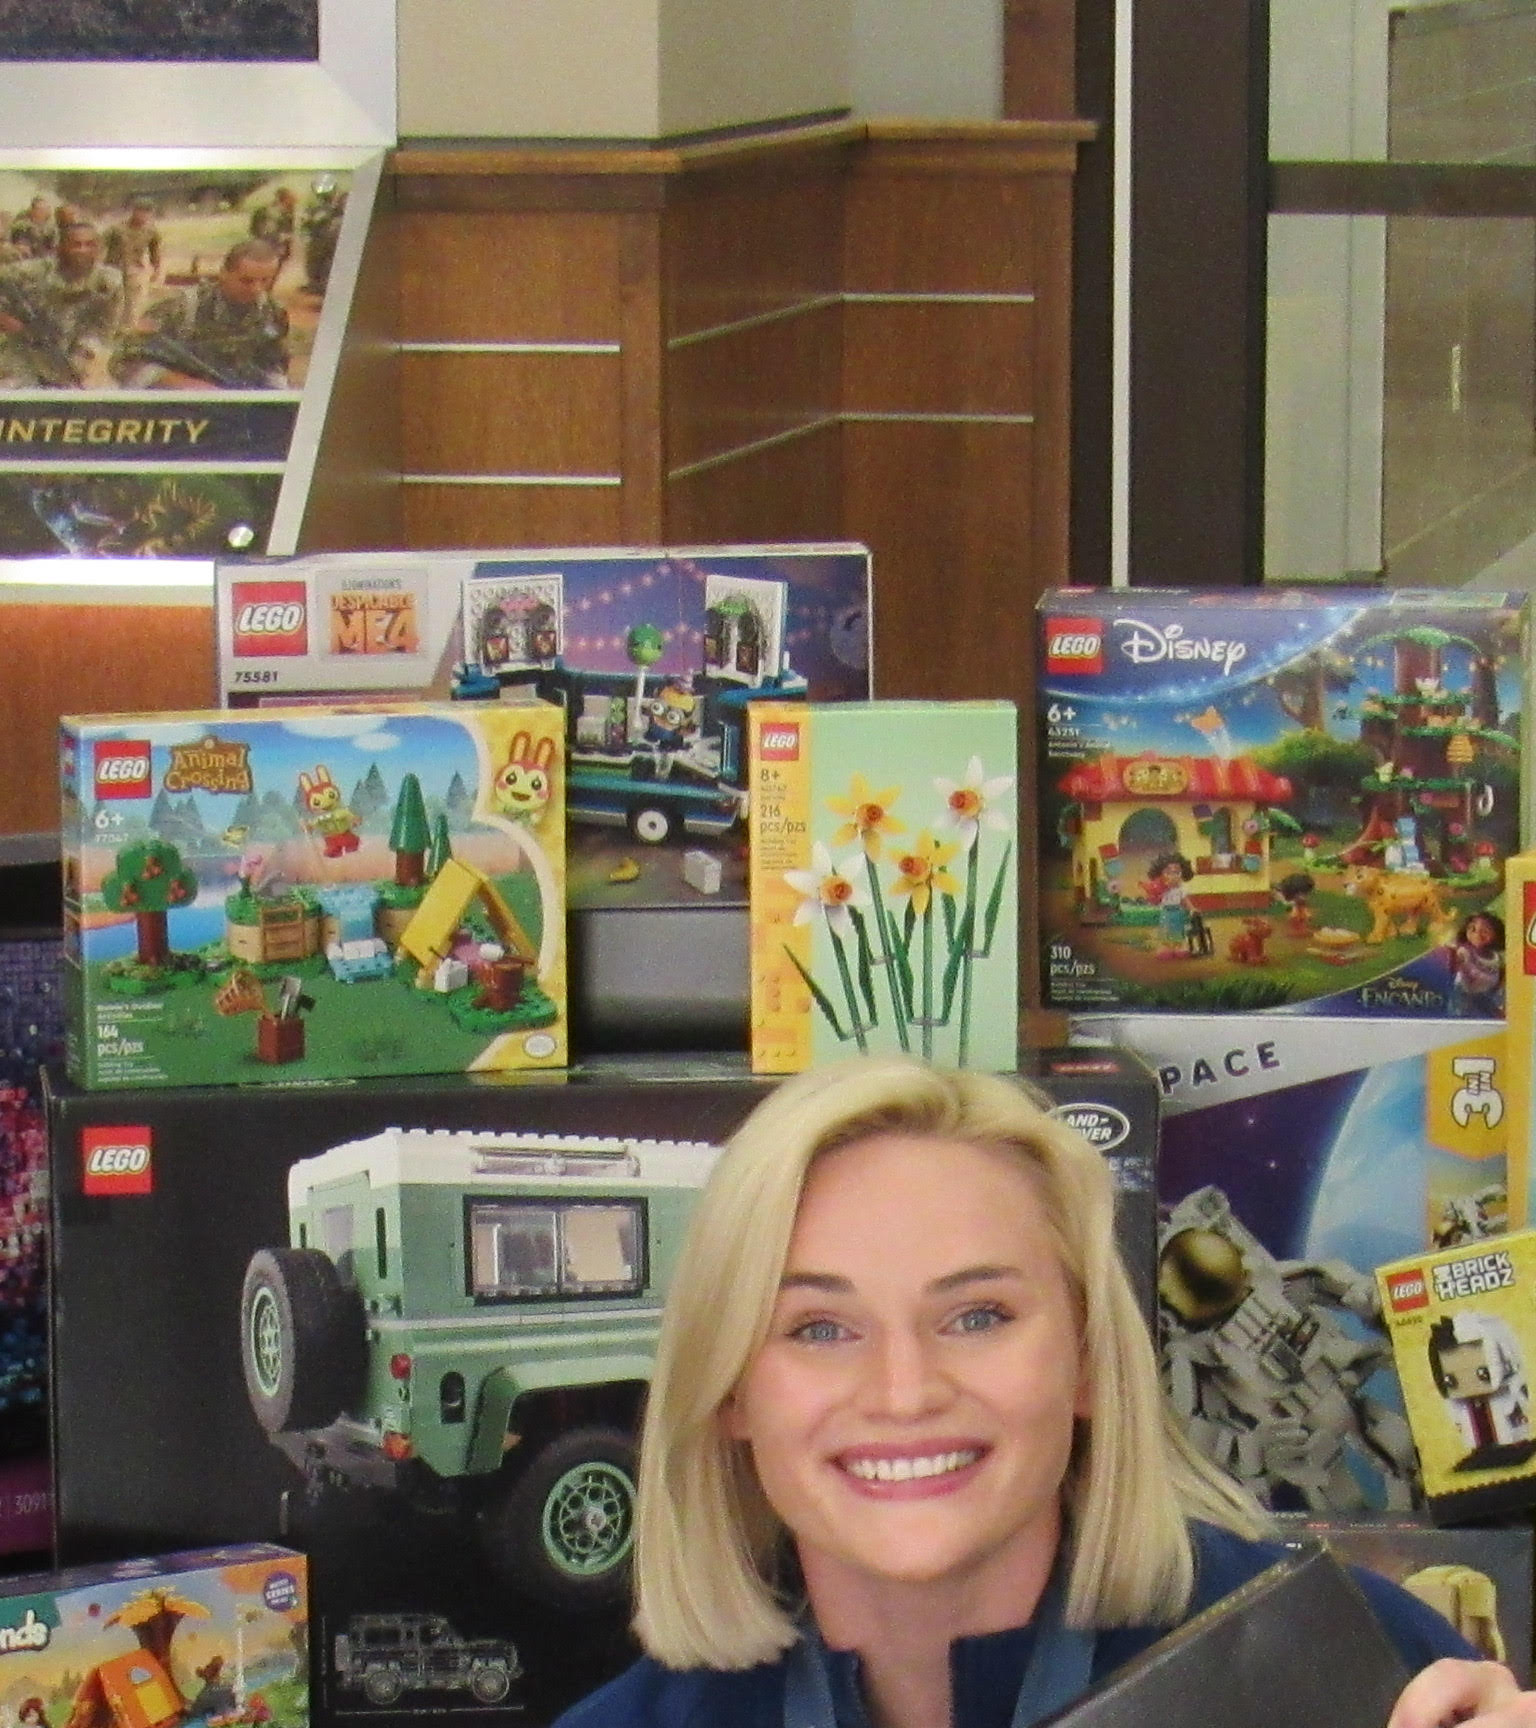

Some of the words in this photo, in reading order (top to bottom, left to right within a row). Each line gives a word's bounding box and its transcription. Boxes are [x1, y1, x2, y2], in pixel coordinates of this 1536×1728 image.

[236, 603, 304, 632] LEGO
[1048, 632, 1099, 659] LEGO
[1112, 618, 1247, 676] Disney
[235, 670, 278, 683] 75581
[1047, 703, 1077, 723] 6+
[764, 732, 798, 749] LEGO
[98, 756, 145, 782] LEGO
[172, 749, 247, 774] Animal
[166, 768, 251, 792] Crossing
[760, 768, 780, 783] 8+
[95, 809, 125, 830] 6+
[1159, 1041, 1280, 1095] PACE
[86, 1145, 148, 1174] LEGO
[1449, 1251, 1511, 1281] BRICK
[1390, 1276, 1425, 1304] LEGO
[1436, 1269, 1516, 1301] HEADZ
